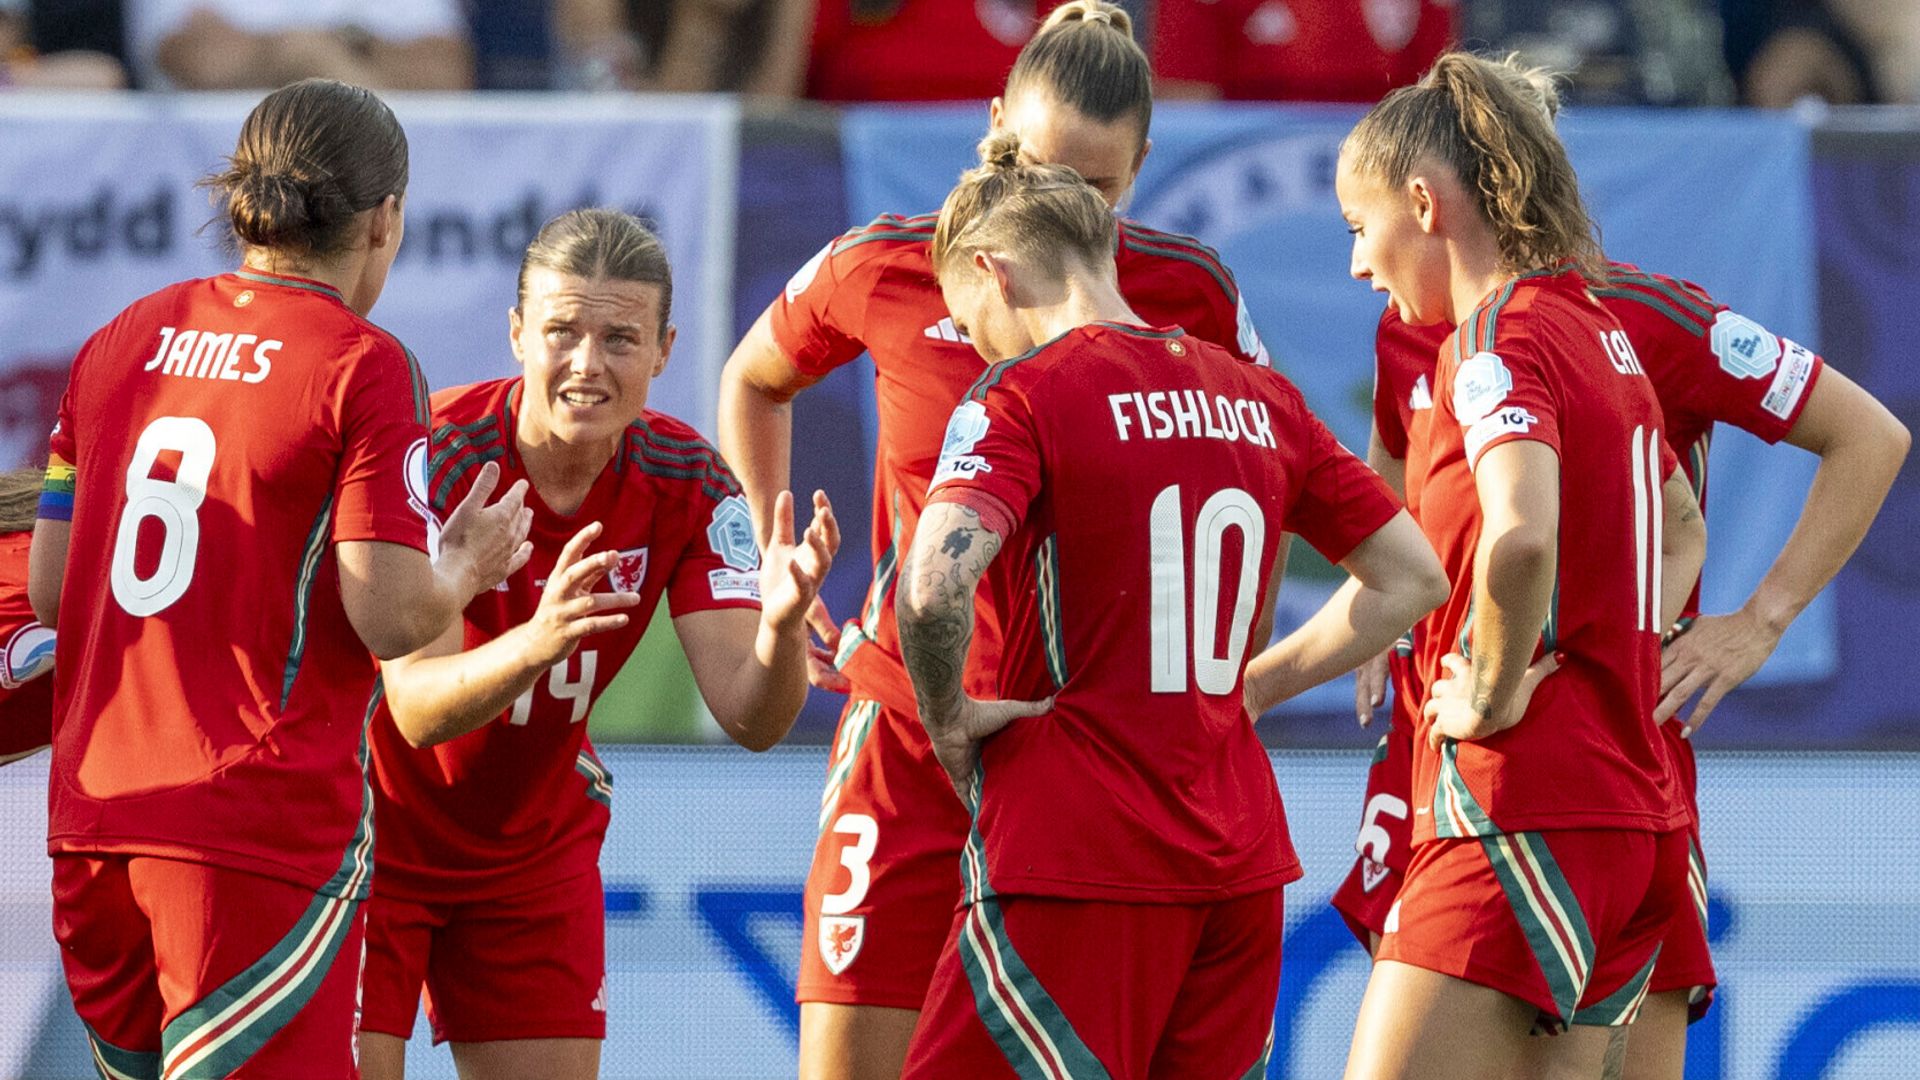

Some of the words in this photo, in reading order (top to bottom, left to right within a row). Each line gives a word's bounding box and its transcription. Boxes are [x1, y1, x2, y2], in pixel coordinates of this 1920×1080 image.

[145, 326, 283, 384] JAMES
[1107, 389, 1278, 450] FISHLOCK
[111, 416, 217, 617] 8
[1149, 484, 1267, 695] 10
[1632, 424, 1664, 634] 11
[821, 813, 879, 915] 3
